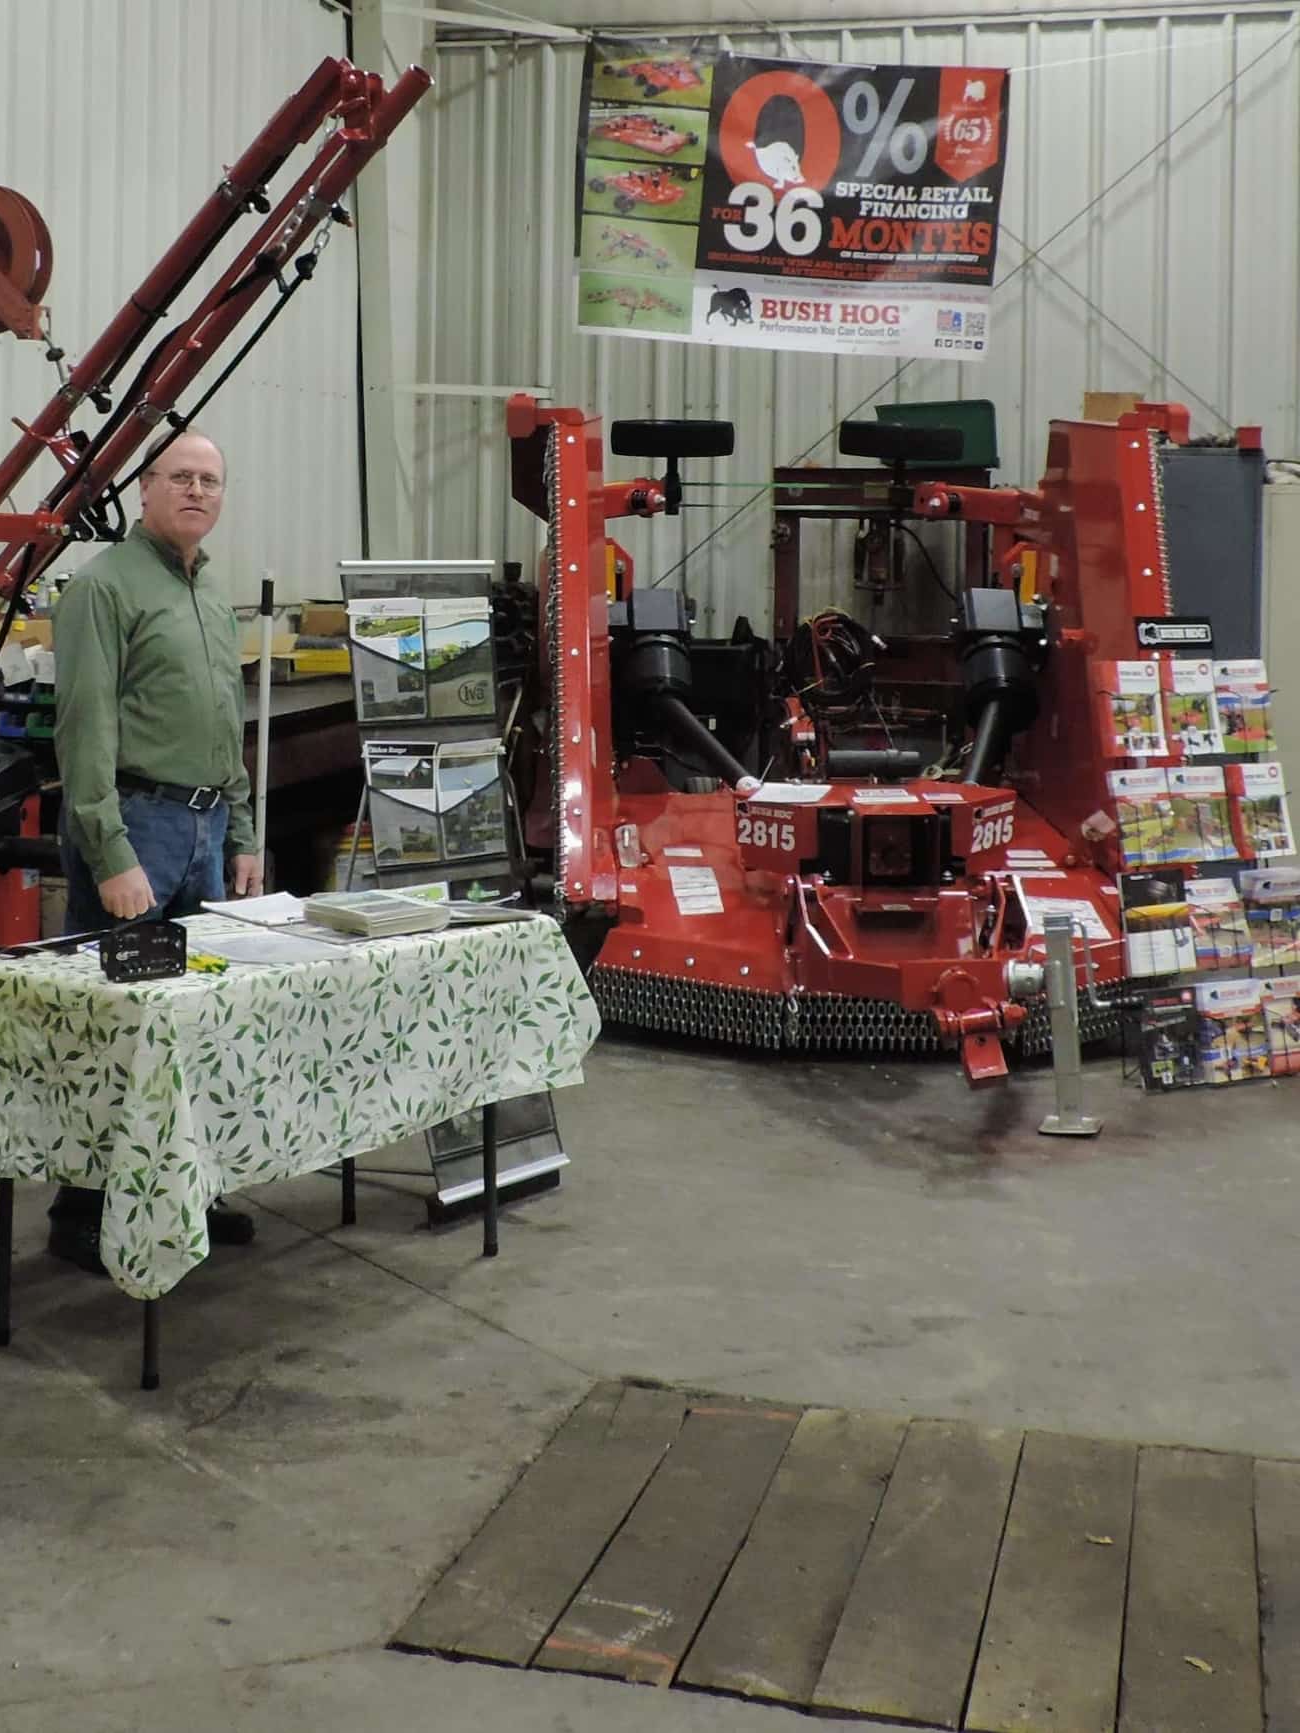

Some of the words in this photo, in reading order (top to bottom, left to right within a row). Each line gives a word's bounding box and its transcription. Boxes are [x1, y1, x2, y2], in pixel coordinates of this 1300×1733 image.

[835, 181, 917, 201] SPECIAL
[920, 186, 993, 203] RETAIL
[711, 207, 744, 223] FOR
[724, 182, 824, 256] 36
[859, 201, 969, 220] FINANCING
[828, 216, 993, 256] MONTHS
[761, 298, 833, 323] BUSH
[839, 303, 900, 325] HOG
[760, 321, 818, 335] Performance
[819, 325, 836, 336] You
[837, 326, 855, 336] Can
[857, 327, 885, 337] Count
[738, 818, 796, 852] 2815
[971, 815, 1014, 854] 2815
